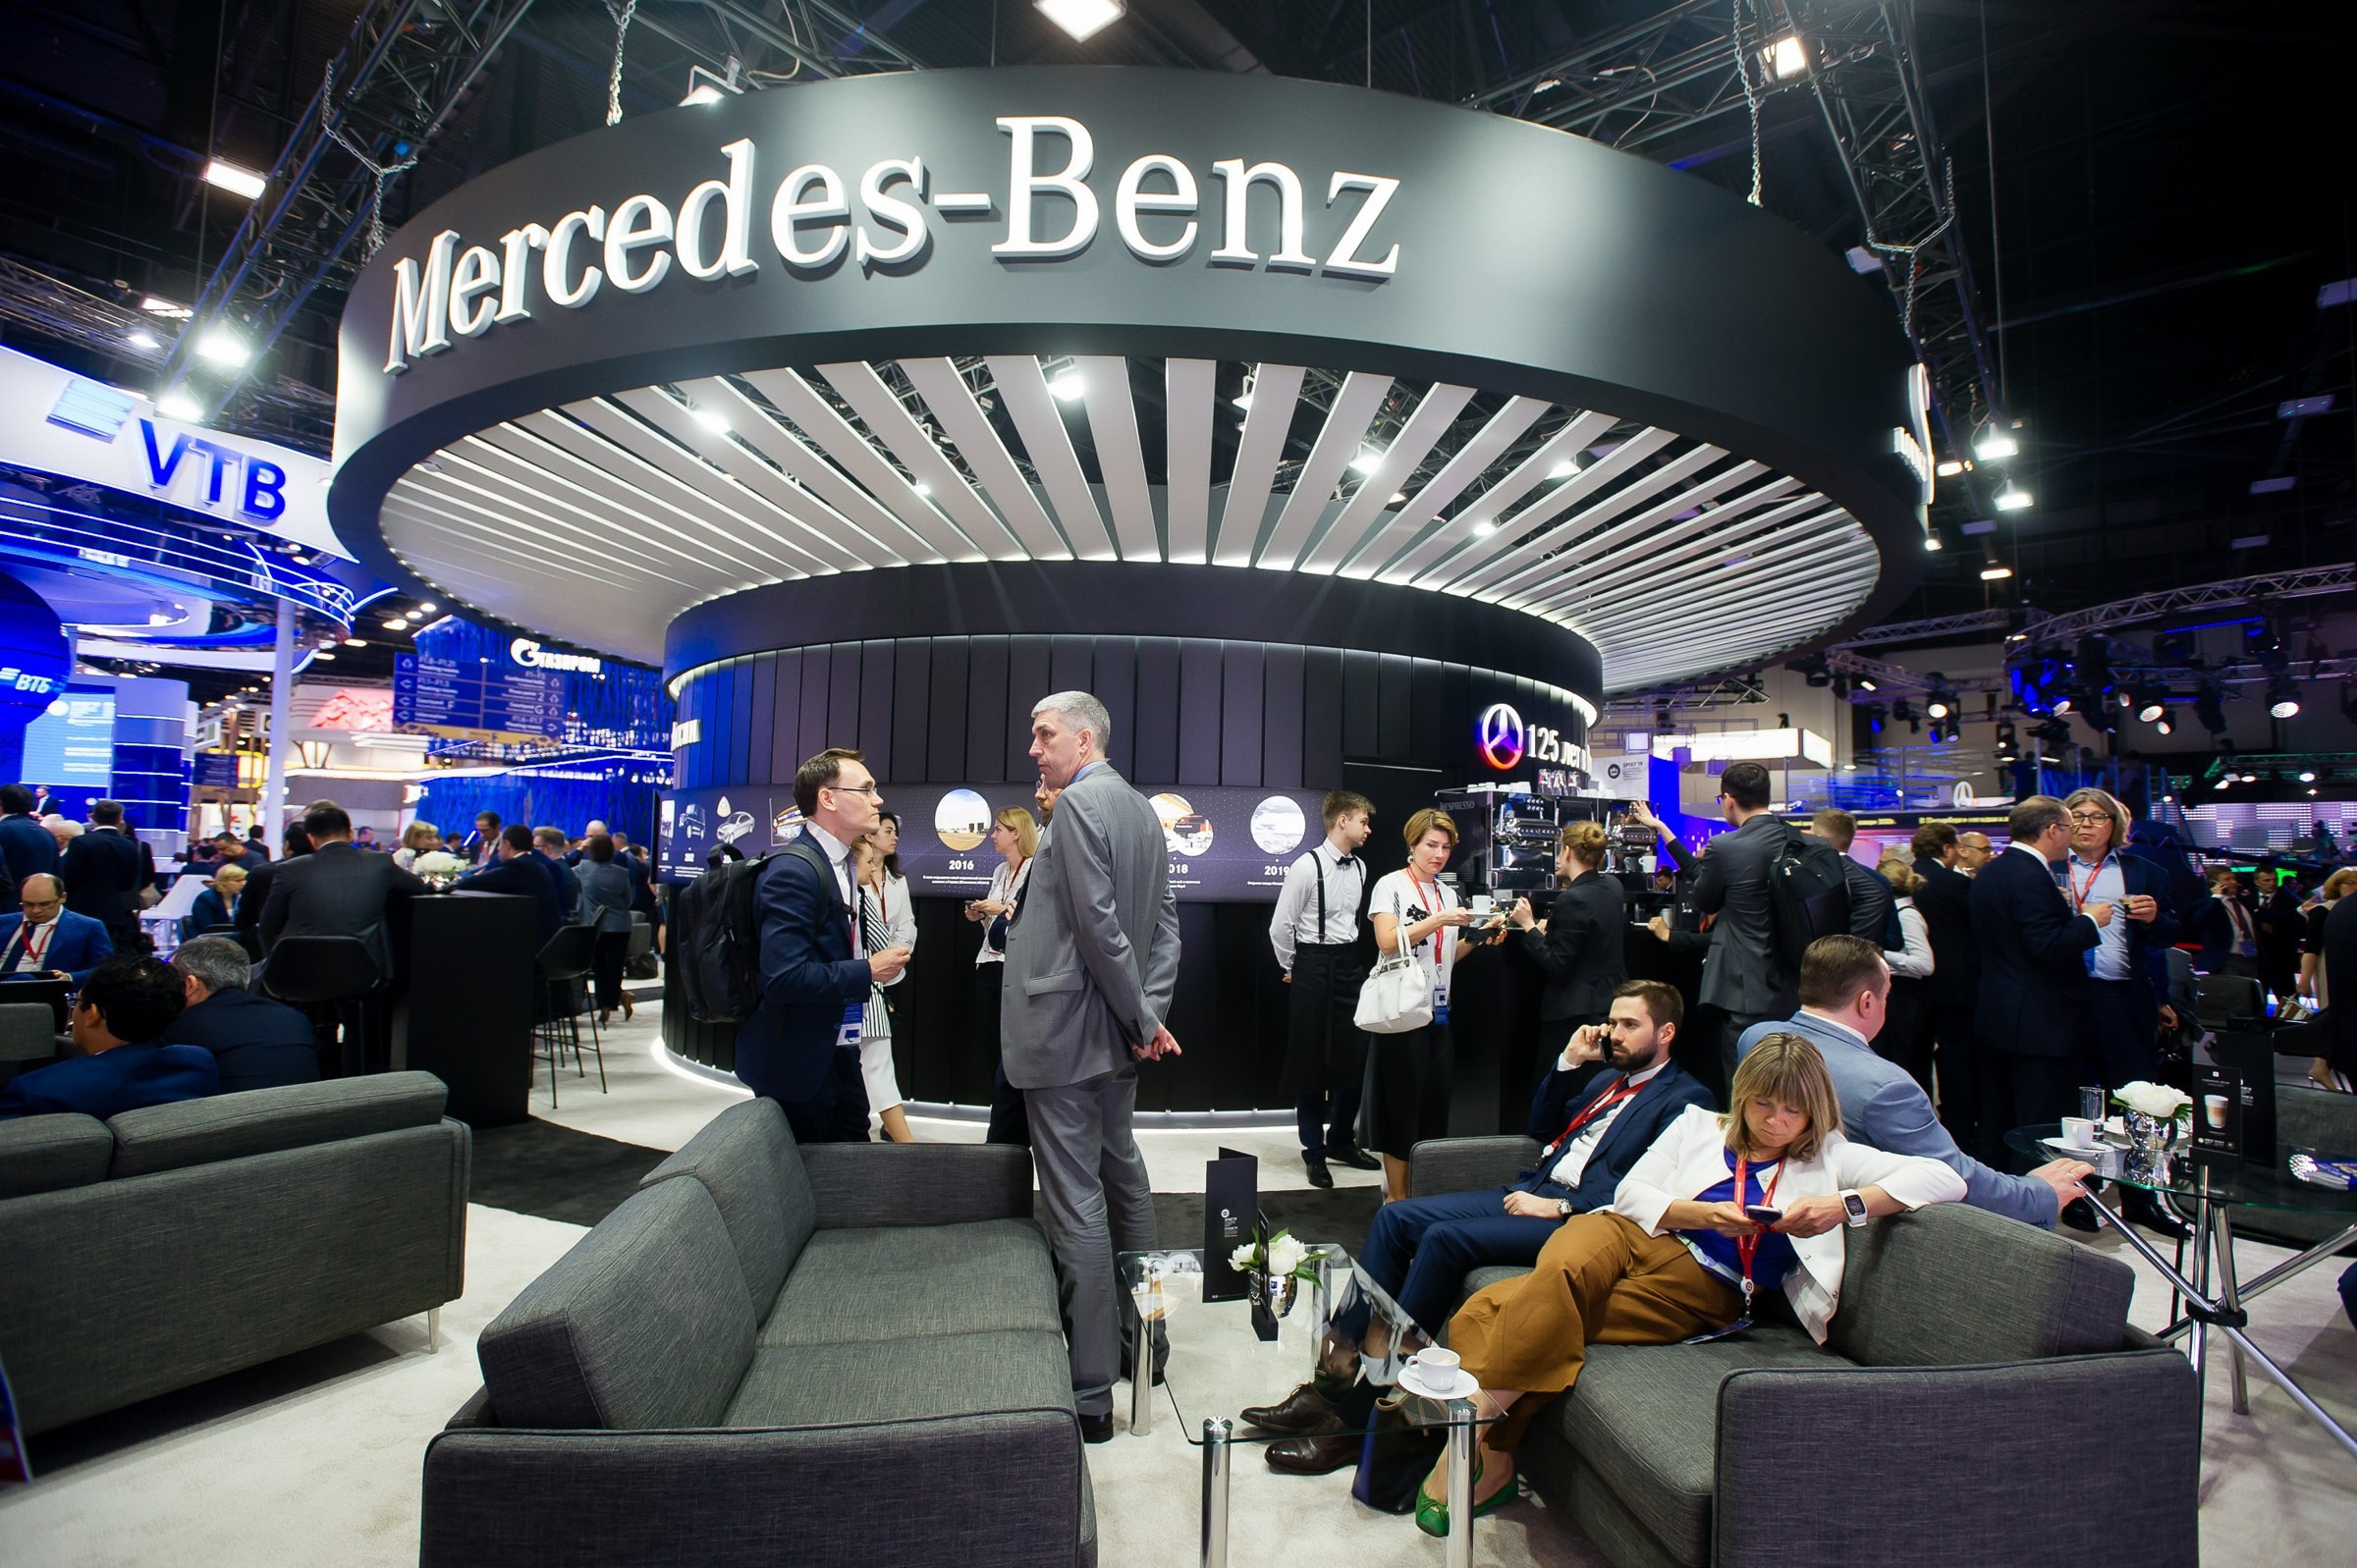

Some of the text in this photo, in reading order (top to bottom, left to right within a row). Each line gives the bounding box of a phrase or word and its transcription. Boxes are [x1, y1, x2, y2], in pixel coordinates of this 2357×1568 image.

[382, 115, 1401, 375] Mercedes-Benz
[137, 417, 287, 523] VTB
[15, 674, 54, 694] ВТБ
[1526, 724, 1560, 763] 125
[948, 859, 975, 871] 2016
[1169, 863, 1188, 874] 018
